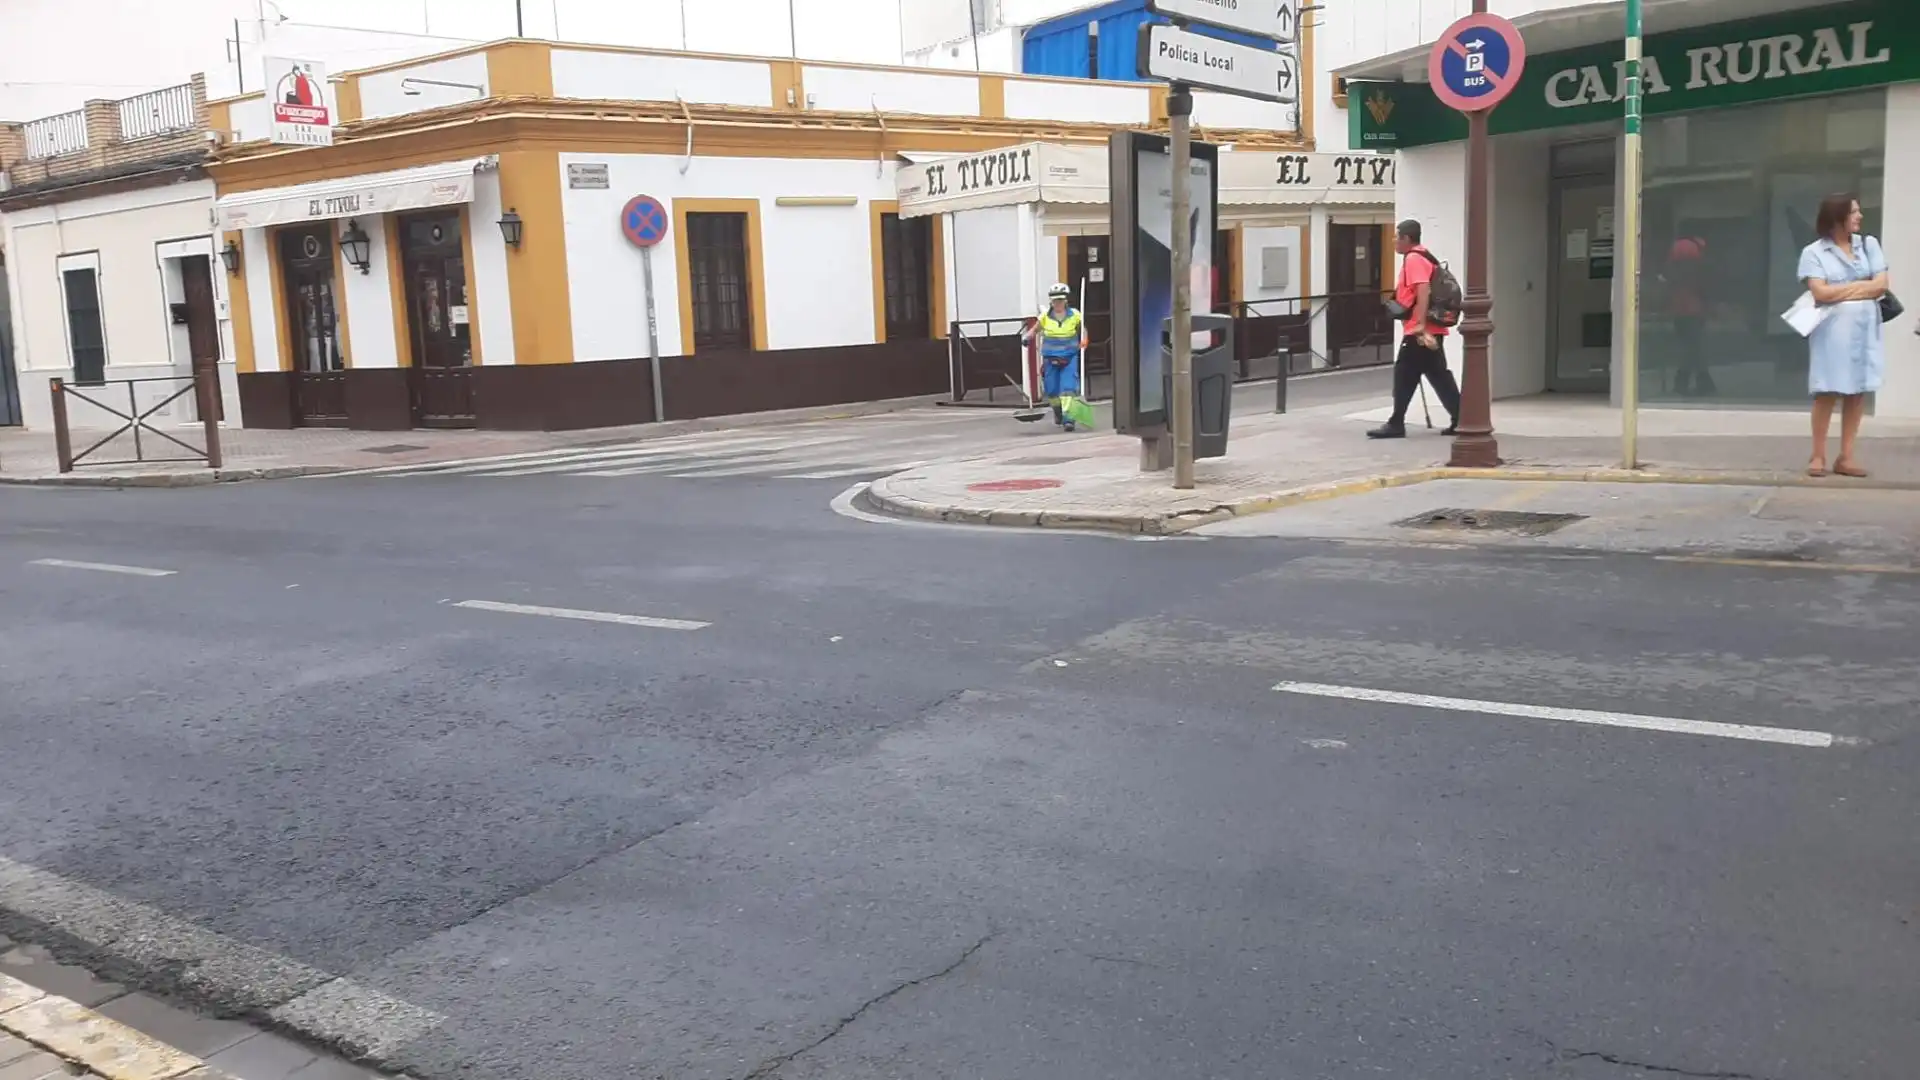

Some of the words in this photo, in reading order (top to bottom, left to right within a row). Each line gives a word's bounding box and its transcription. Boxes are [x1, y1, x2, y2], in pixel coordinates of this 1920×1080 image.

[1203, 51, 1234, 72] Local
[1469, 56, 1480, 69] P
[1686, 21, 1890, 90] RURAL
[1464, 76, 1485, 87] BUS
[925, 164, 948, 196] EL
[957, 148, 1031, 191] TIVOLI
[1276, 155, 1311, 185] EL
[1334, 156, 1395, 185] TIV
[309, 199, 322, 216] EL
[324, 194, 360, 214] TIVOLI
